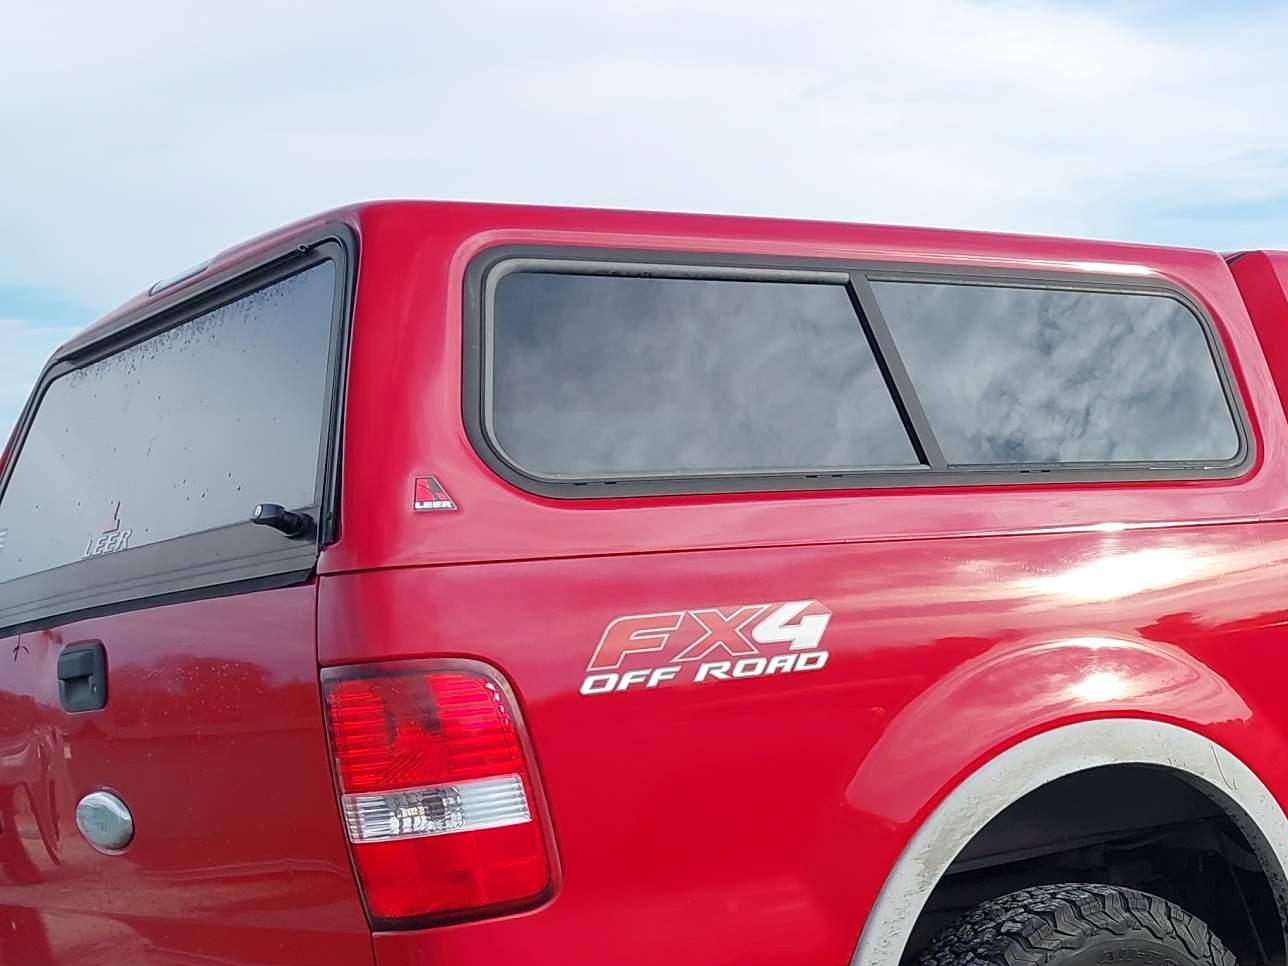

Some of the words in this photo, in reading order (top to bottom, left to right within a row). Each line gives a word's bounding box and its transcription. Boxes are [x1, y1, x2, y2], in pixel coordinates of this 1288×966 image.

[415, 500, 452, 509] LEER
[80, 528, 132, 560] LEER
[586, 599, 833, 672] FX4
[579, 665, 681, 695] OFF
[693, 651, 829, 684] ROAD
